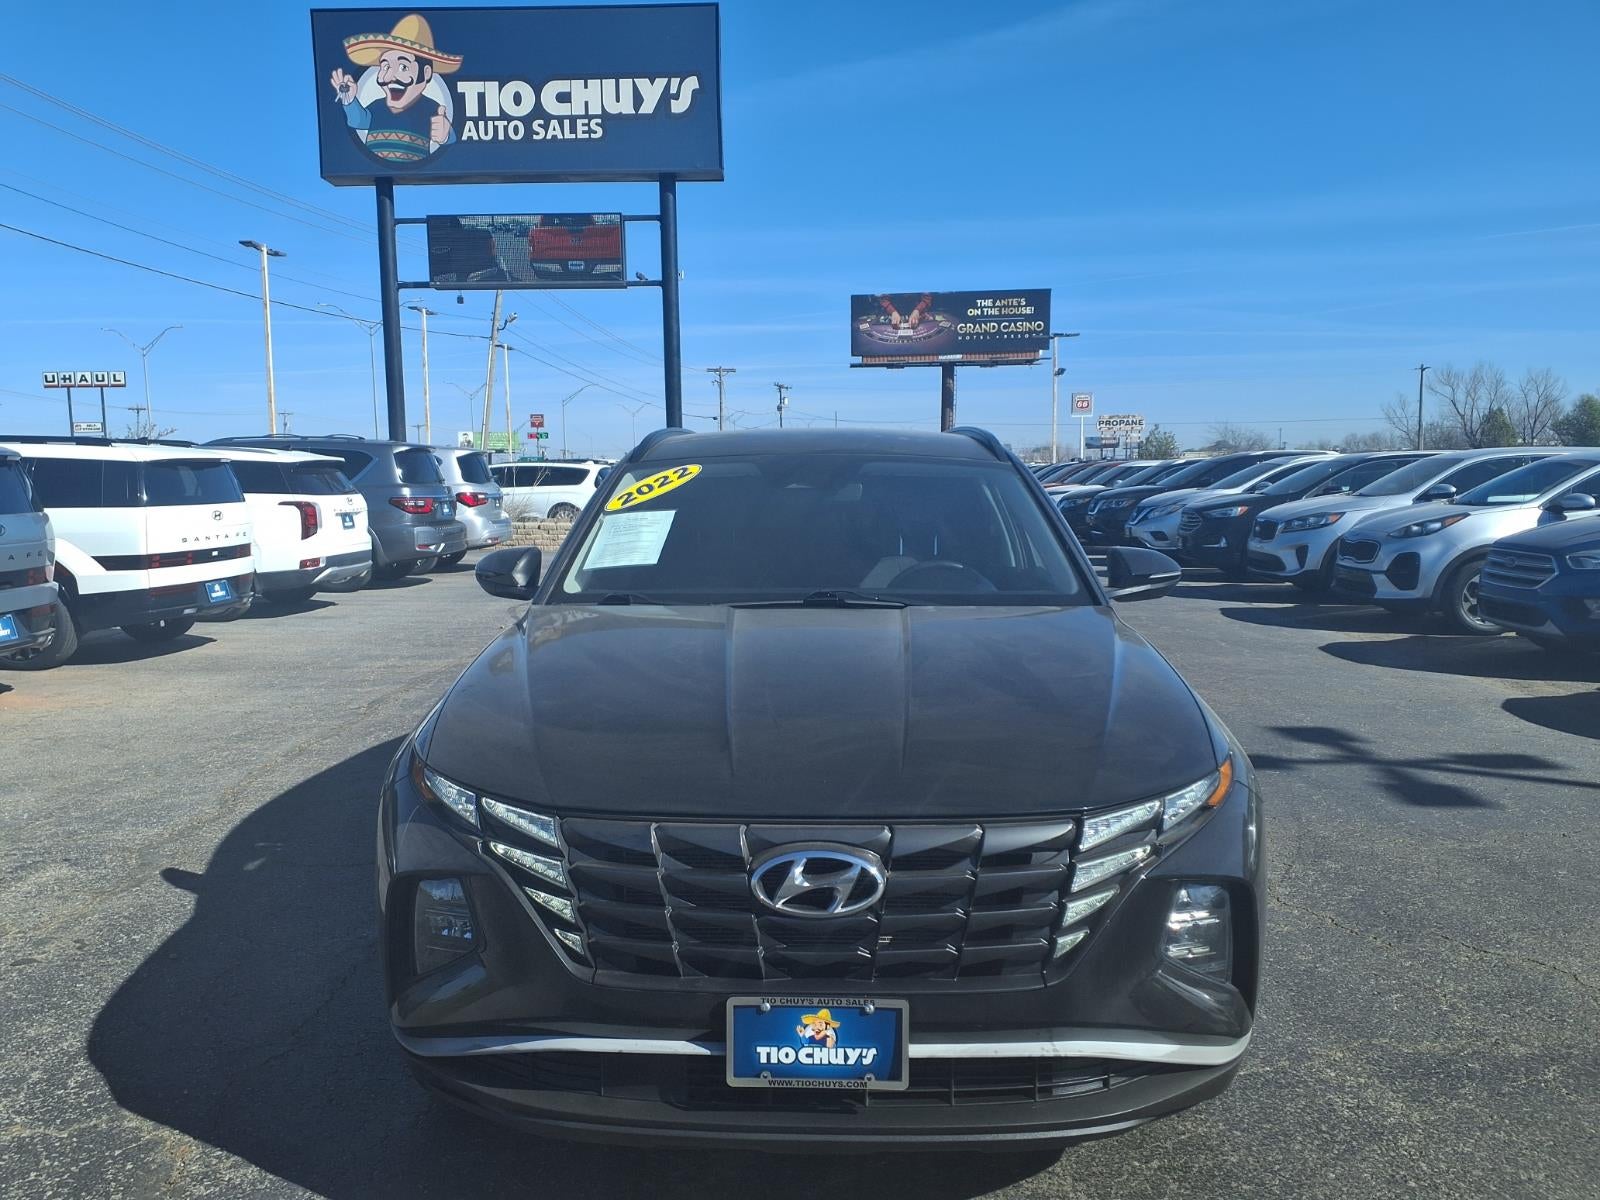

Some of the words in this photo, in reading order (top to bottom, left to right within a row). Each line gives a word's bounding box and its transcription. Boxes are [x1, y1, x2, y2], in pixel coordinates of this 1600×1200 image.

[457, 80, 536, 117] TIO
[540, 76, 699, 116] CHUY'S
[461, 119, 525, 141] AUTO
[532, 117, 603, 140] SALES
[976, 299, 993, 307] THE
[994, 298, 1026, 306] ANTE'S
[967, 308, 981, 316] ON
[982, 307, 1000, 316] THE
[1001, 306, 1035, 315] HOUSE!
[957, 322, 998, 334] GRAND
[1000, 321, 1044, 332] CASINO
[1098, 419, 1144, 427] PROPANE
[617, 467, 692, 506] 2022
[181, 533, 229, 543] SANTA
[761, 997, 777, 1005] TIO
[779, 997, 814, 1005] CHUY'S
[815, 998, 843, 1006] AUTO
[845, 998, 875, 1006] SALES
[756, 1046, 796, 1063] TIO
[797, 1046, 877, 1065] CHUY'S
[768, 1079, 868, 1088] WWW.TIOCHUYS.COM
